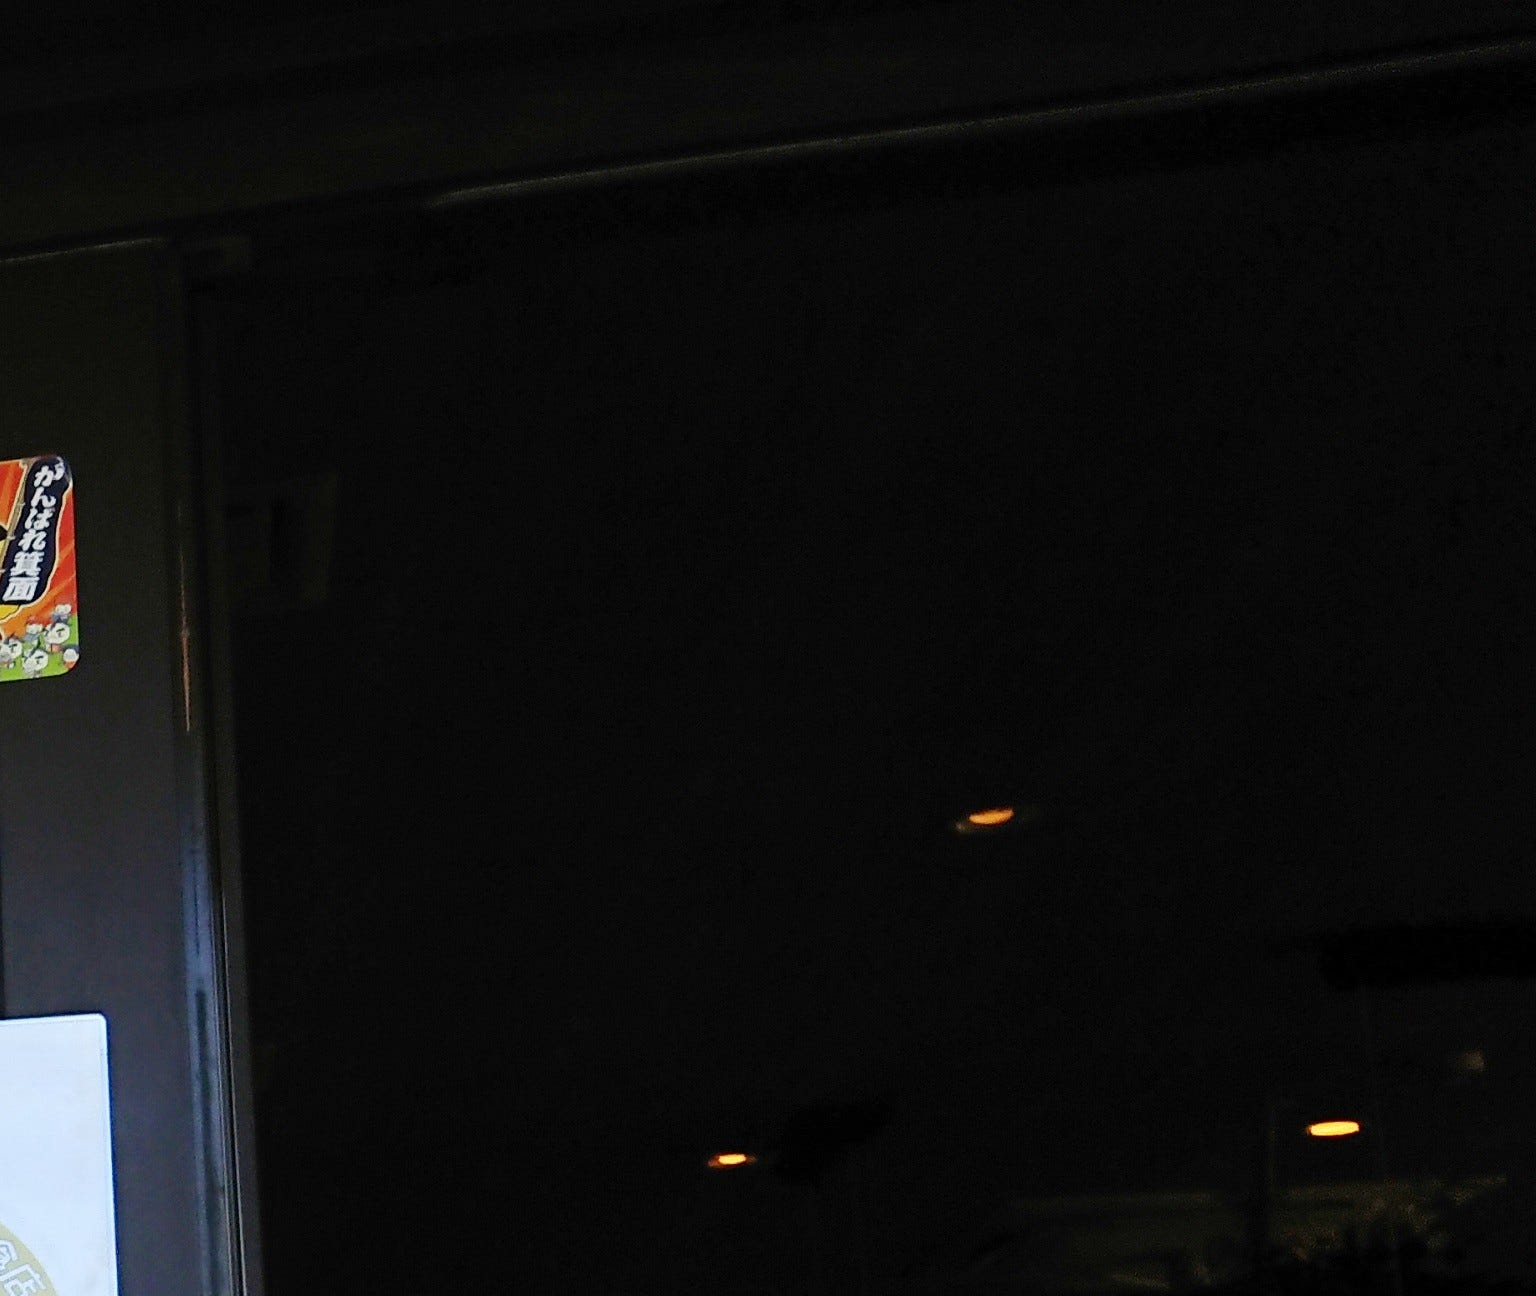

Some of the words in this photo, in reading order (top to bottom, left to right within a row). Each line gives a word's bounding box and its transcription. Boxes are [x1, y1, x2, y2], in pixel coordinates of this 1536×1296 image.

[1, 458, 64, 601] がんばれ箕面
